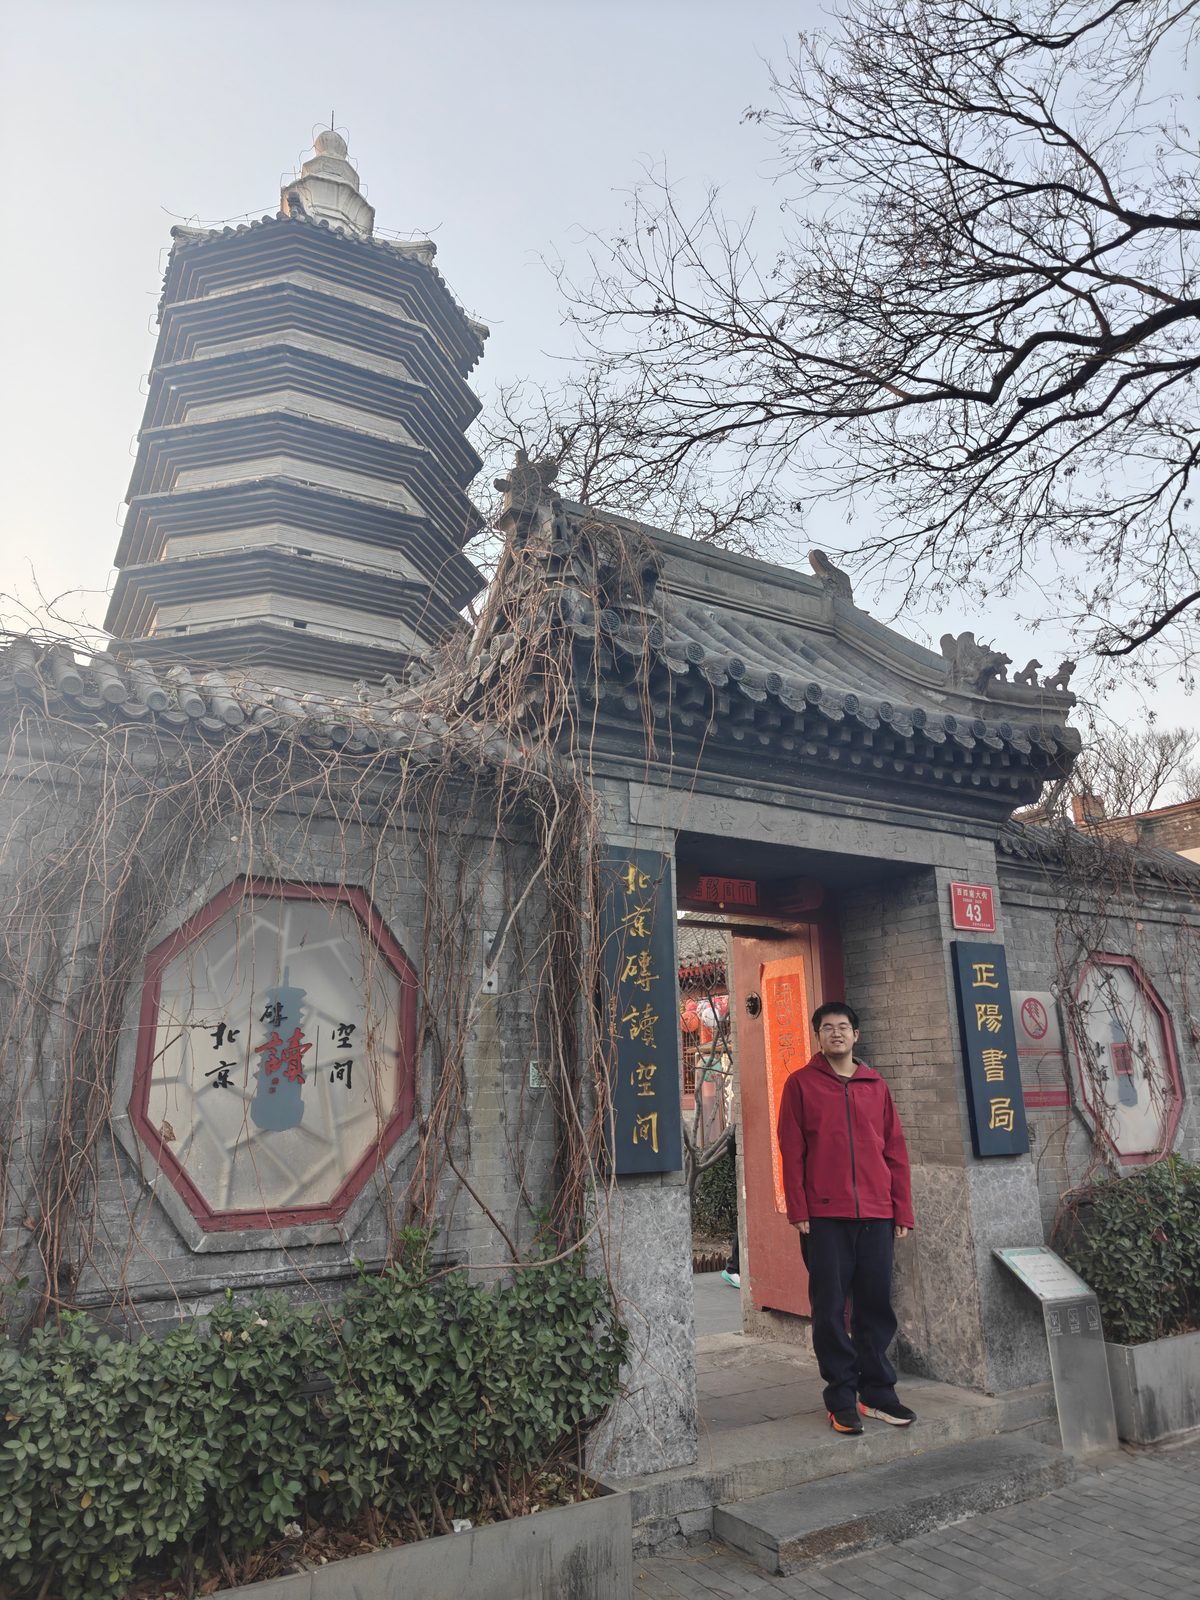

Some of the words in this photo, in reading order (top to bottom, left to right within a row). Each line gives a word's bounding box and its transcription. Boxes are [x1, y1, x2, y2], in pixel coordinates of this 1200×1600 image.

[965, 903, 982, 922] 43
[204, 1022, 240, 1088] 北京
[972, 963, 1015, 1131] 正陽書局
